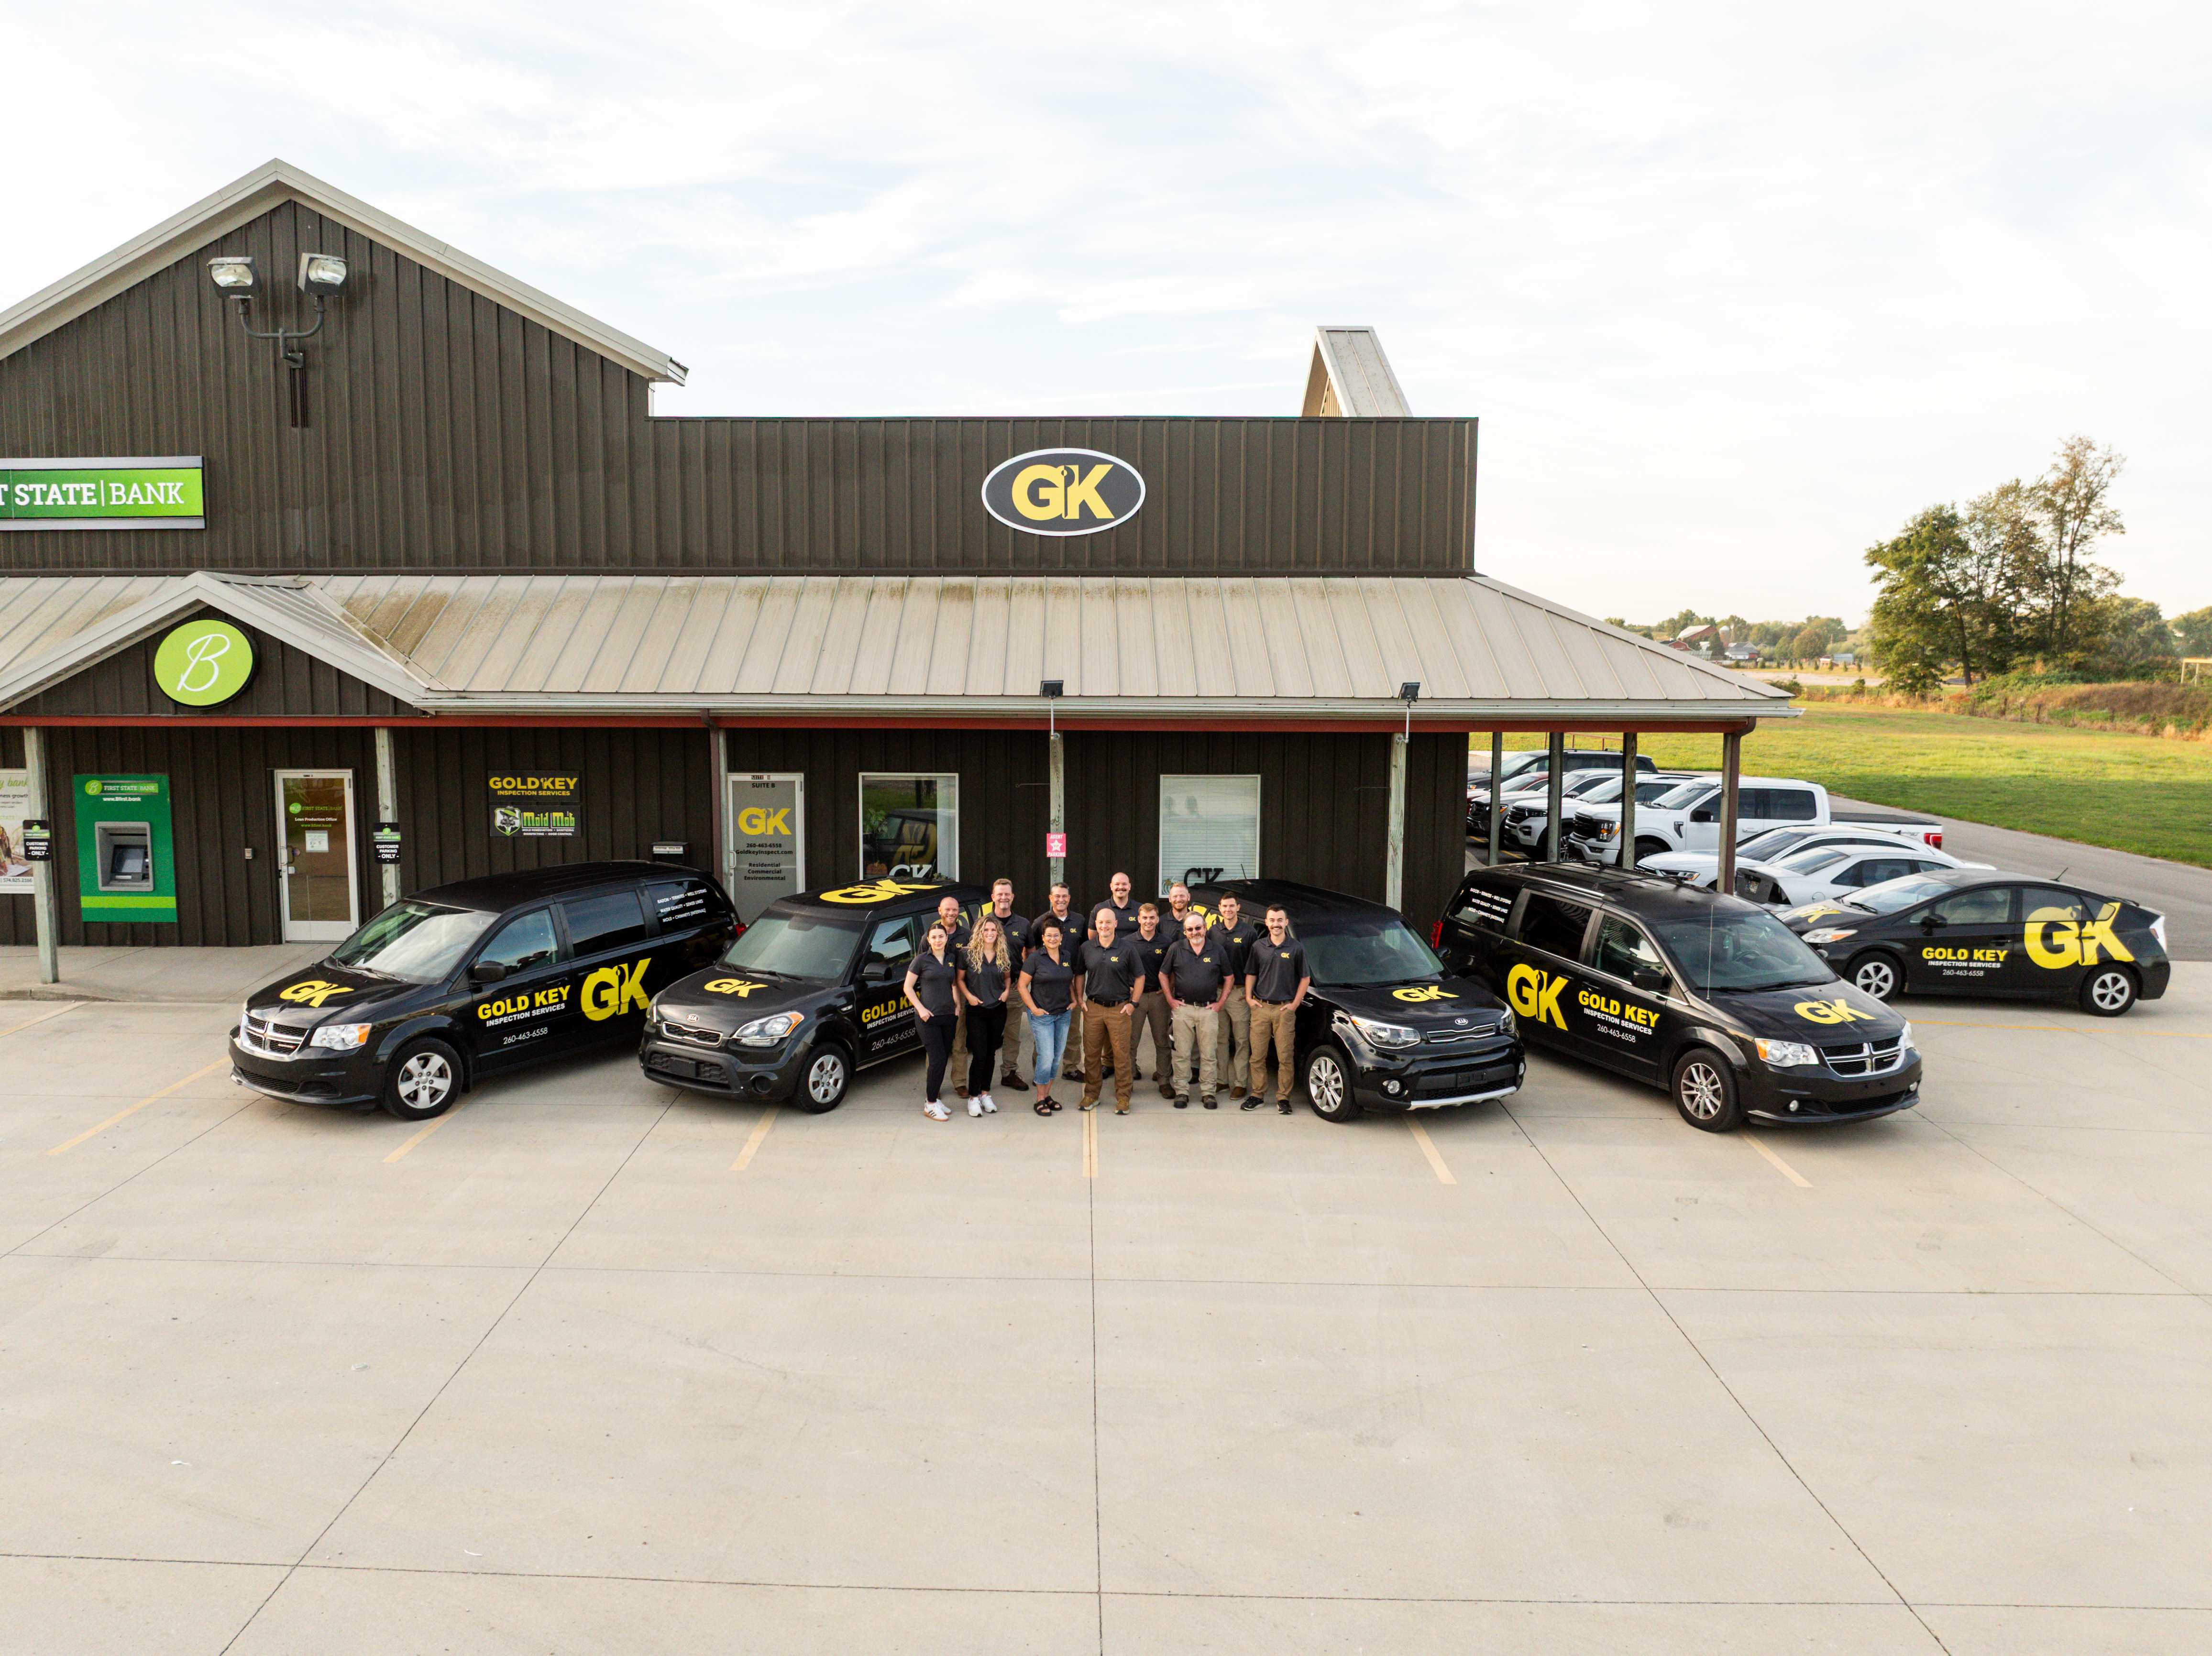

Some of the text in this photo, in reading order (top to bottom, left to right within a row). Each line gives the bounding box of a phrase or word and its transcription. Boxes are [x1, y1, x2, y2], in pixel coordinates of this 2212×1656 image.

[15, 483, 96, 506] STATE
[110, 483, 184, 504] BANK
[1012, 464, 1114, 520] GK
[177, 634, 230, 691] B
[489, 777, 578, 789] GOLD KEY
[522, 811, 575, 827] Mold Mob
[738, 807, 792, 835] GK
[2024, 902, 2135, 969] GK
[1922, 947, 2008, 961] GOLD KEY
[279, 980, 354, 1008] GK
[581, 958, 651, 1021] GK
[704, 978, 768, 998] GK
[1392, 986, 1459, 1002] GK
[1507, 964, 1568, 1031] GK
[477, 985, 571, 1020] GOLD KEY
[862, 1000, 896, 1023] GOLD
[1578, 990, 1660, 1027] GOLD KEY
[1794, 998, 1876, 1024] GK
[486, 1003, 565, 1027] INSPECTION SERVICES
[867, 1008, 916, 1029] INSPECTION SERVIC
[1584, 1008, 1652, 1035] INSPECTION SERVICES
[503, 1027, 548, 1044] 260-463-6558
[871, 1027, 916, 1051] 260-463-6558
[1597, 1024, 1636, 1042] 260-463-6558
